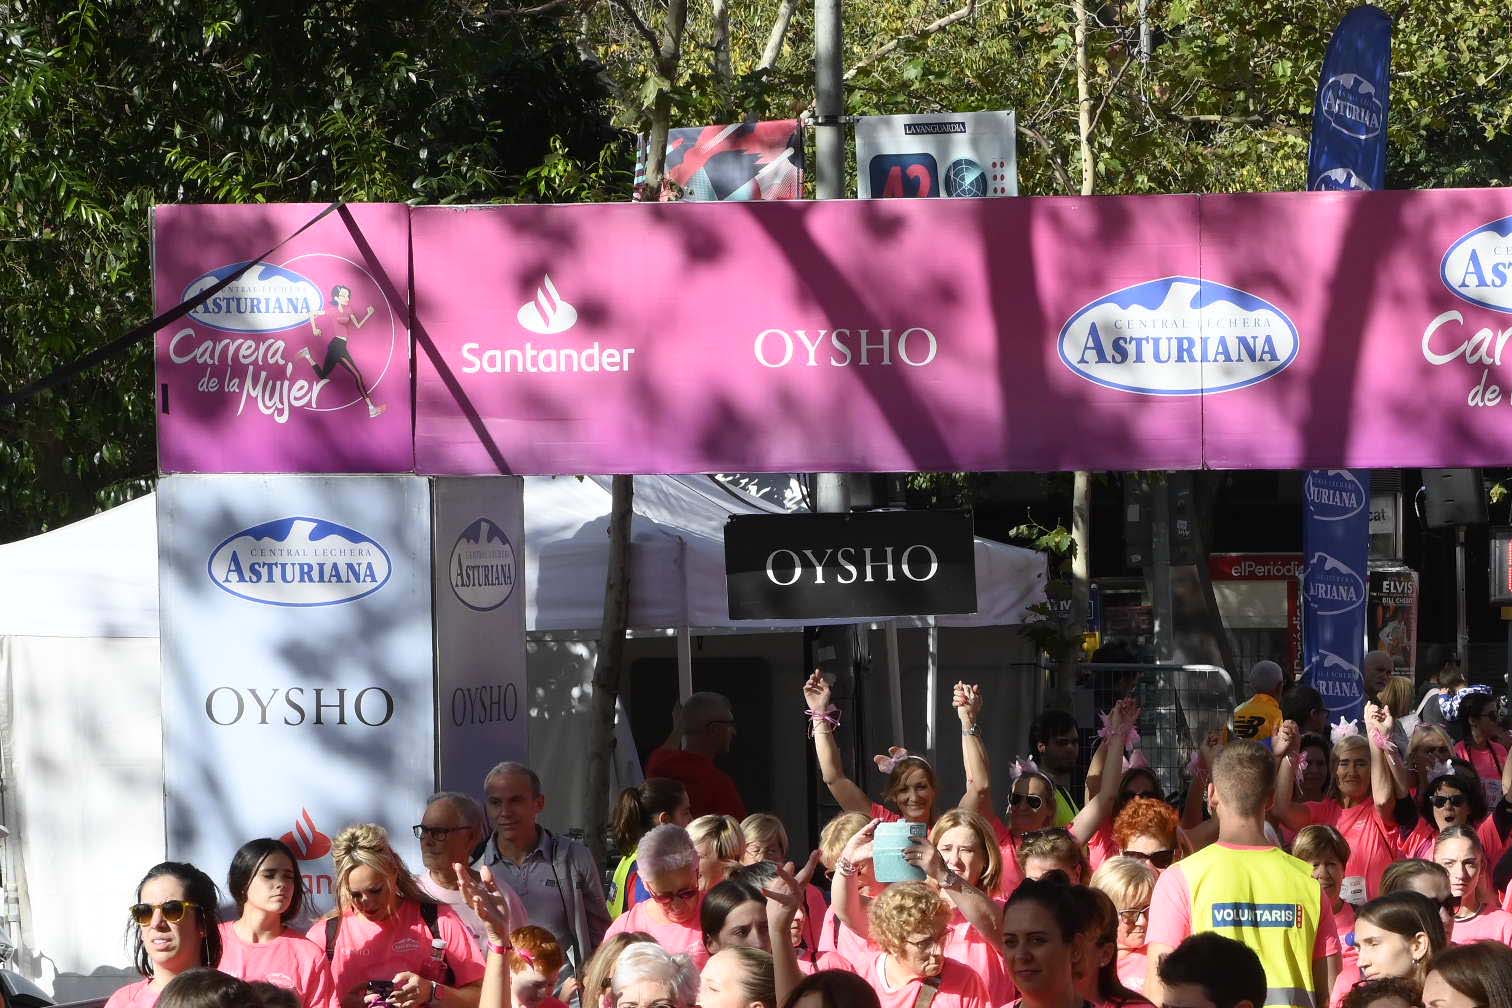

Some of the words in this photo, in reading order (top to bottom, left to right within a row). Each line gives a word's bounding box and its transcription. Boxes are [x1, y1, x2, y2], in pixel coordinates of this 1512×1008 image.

[169, 328, 286, 366] Carrera
[460, 341, 635, 374] Santander
[754, 327, 938, 368] OYSHO
[1077, 325, 1281, 364] ASTURIANA
[198, 367, 220, 392] de
[225, 364, 241, 392] la
[237, 362, 330, 424] Mujer
[1467, 368, 1502, 408] de
[223, 550, 378, 584] ASTURIANA
[250, 548, 309, 557] CENTRAL
[313, 547, 372, 557] LECHERA
[455, 553, 513, 588] ASTURIANA
[766, 544, 939, 586] OYSHO
[1382, 580, 1413, 593] ELVIS
[205, 686, 394, 727] OYSHO
[451, 682, 518, 728] OYSHO
[1213, 909, 1293, 922] VOLUNTARIS
